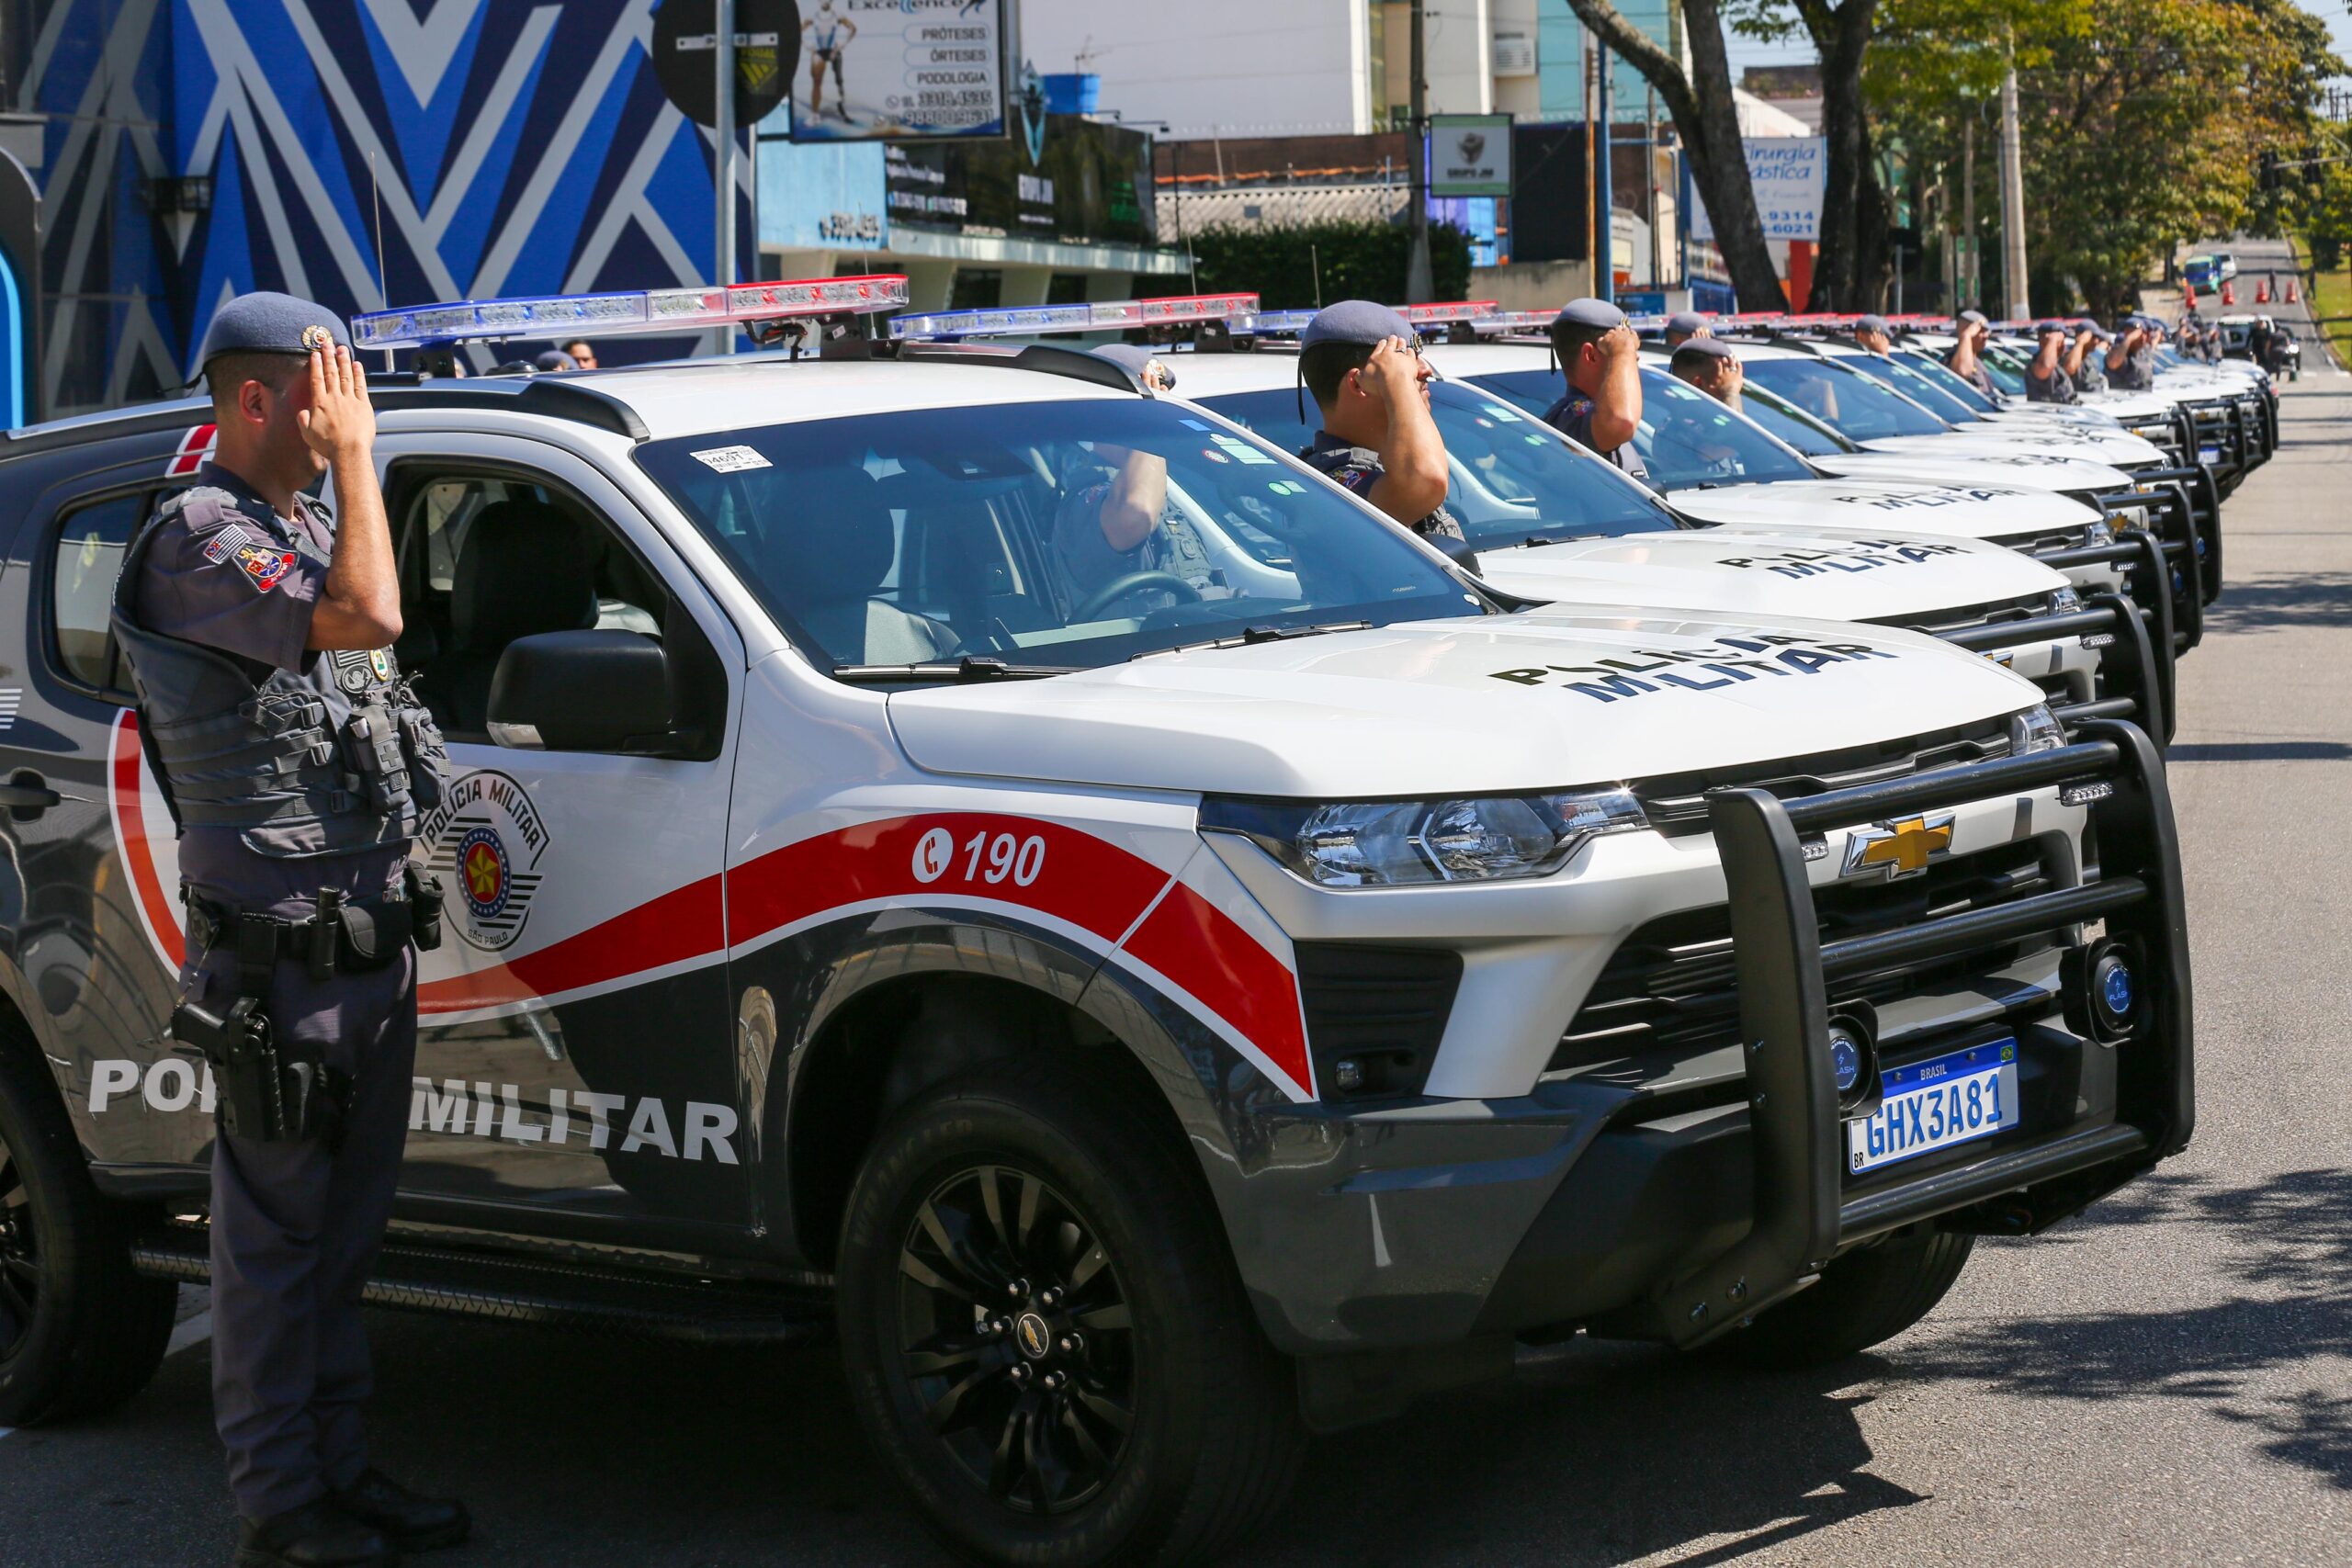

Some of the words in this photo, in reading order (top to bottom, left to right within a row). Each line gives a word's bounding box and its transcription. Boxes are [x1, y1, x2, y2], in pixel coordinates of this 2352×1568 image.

[922, 26, 986, 40] PRÓTESES
[930, 50, 987, 62] ÓRTESES
[917, 72, 987, 85] PODOLOGIA
[1745, 143, 1816, 165] irurgia
[1751, 162, 1811, 180] ástica
[1764, 545, 1976, 580] MLITAR
[489, 779, 540, 852] MILITAR
[965, 831, 1046, 887] 190
[468, 928, 483, 943] SÃO
[485, 931, 508, 945] PAULO
[1920, 1064, 1948, 1081] BRASIL
[409, 1077, 740, 1165] MILITAR
[1867, 1073, 2003, 1158] GHX3A81
[1854, 1151, 1864, 1168] BR
